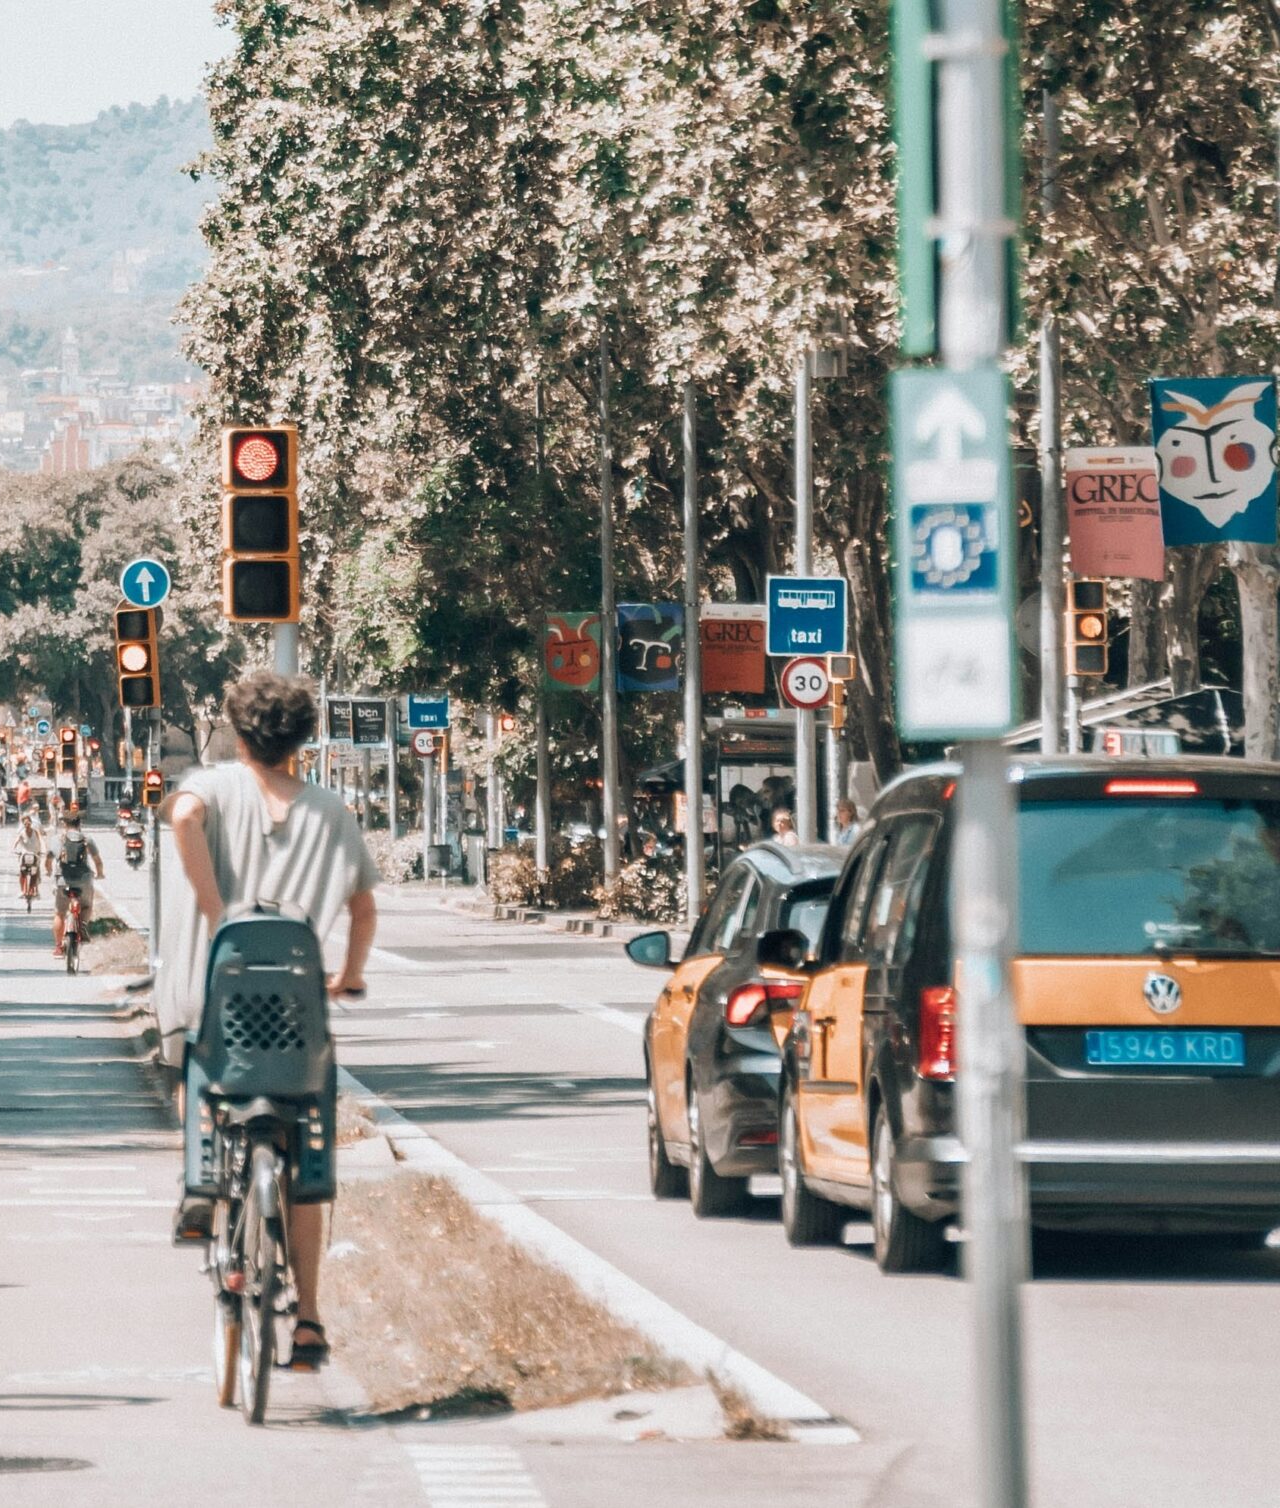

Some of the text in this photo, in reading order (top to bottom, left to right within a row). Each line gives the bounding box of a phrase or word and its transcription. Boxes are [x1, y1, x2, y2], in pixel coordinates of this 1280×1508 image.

[1072, 473, 1159, 504] GREC
[704, 622, 763, 643] GREC
[791, 628, 822, 644] taxi
[794, 675, 822, 691] 30
[357, 708, 378, 718] bcn
[1107, 1036, 1236, 1060] 5946 KRD
